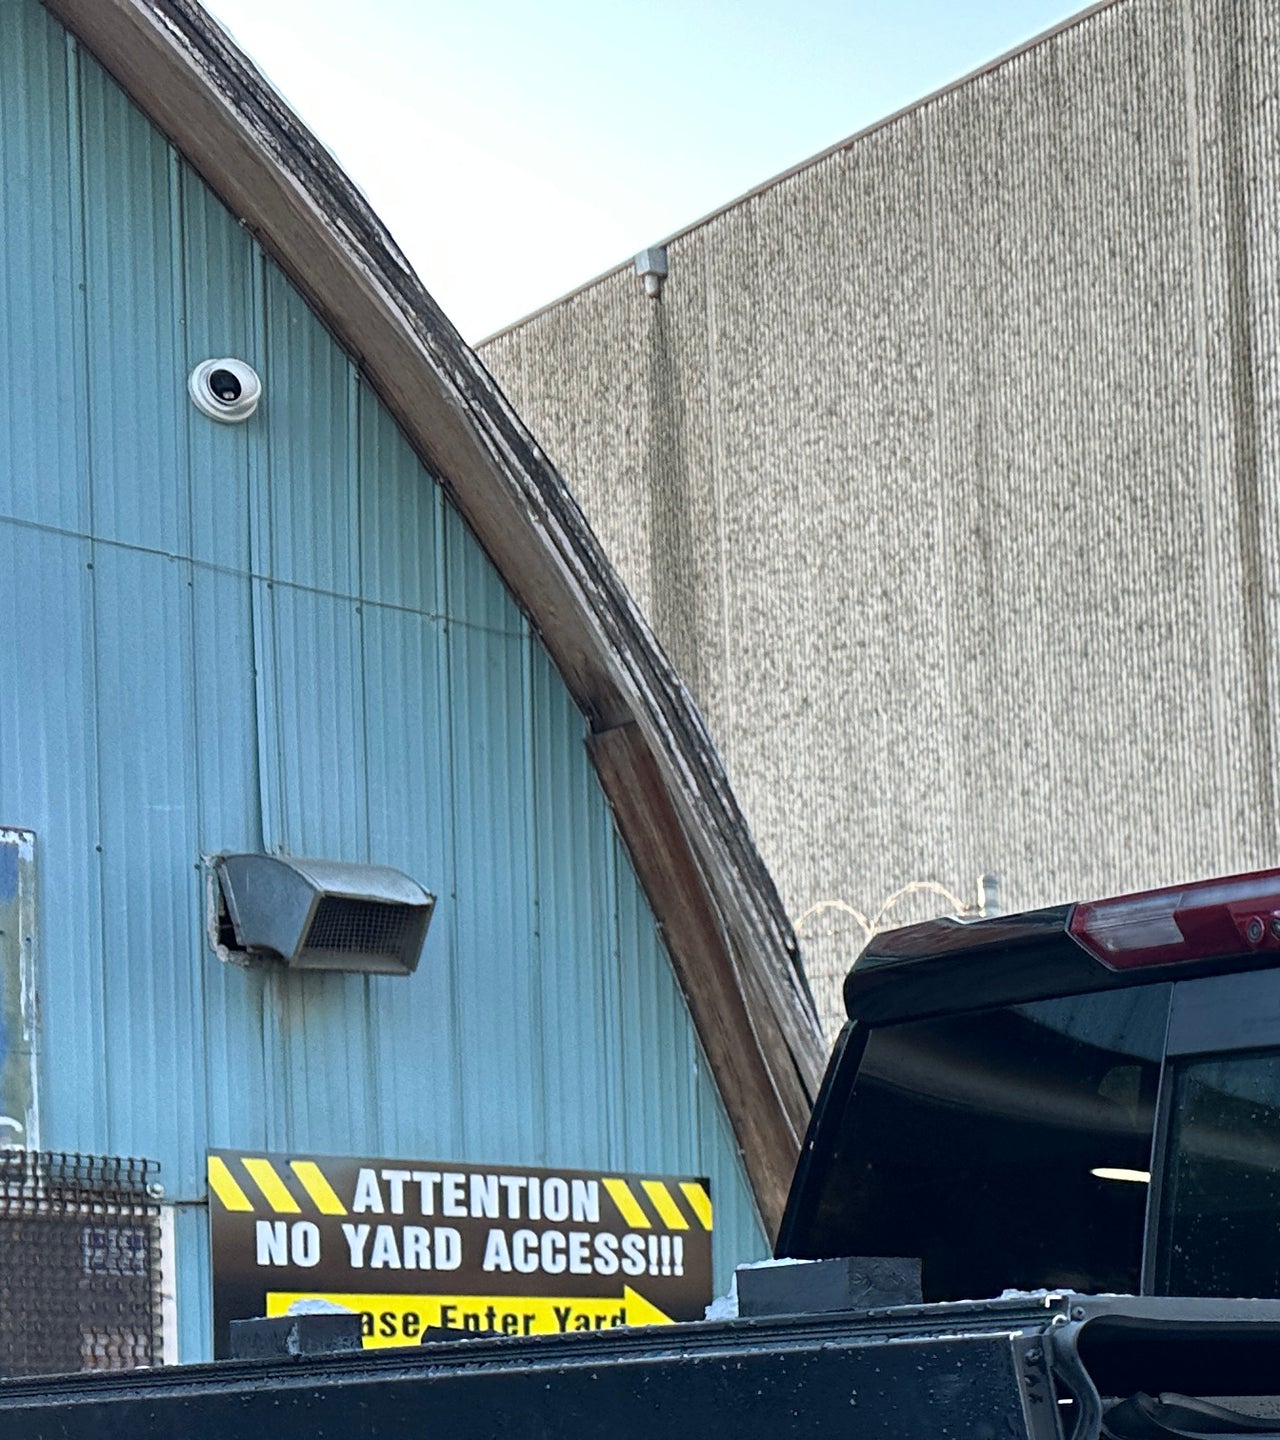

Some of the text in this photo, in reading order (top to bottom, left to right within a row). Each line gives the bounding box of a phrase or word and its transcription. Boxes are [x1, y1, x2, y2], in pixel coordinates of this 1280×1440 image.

[353, 1168, 600, 1223] ATTENTION
[255, 1220, 686, 1277] NO YARD ACCESS!!!
